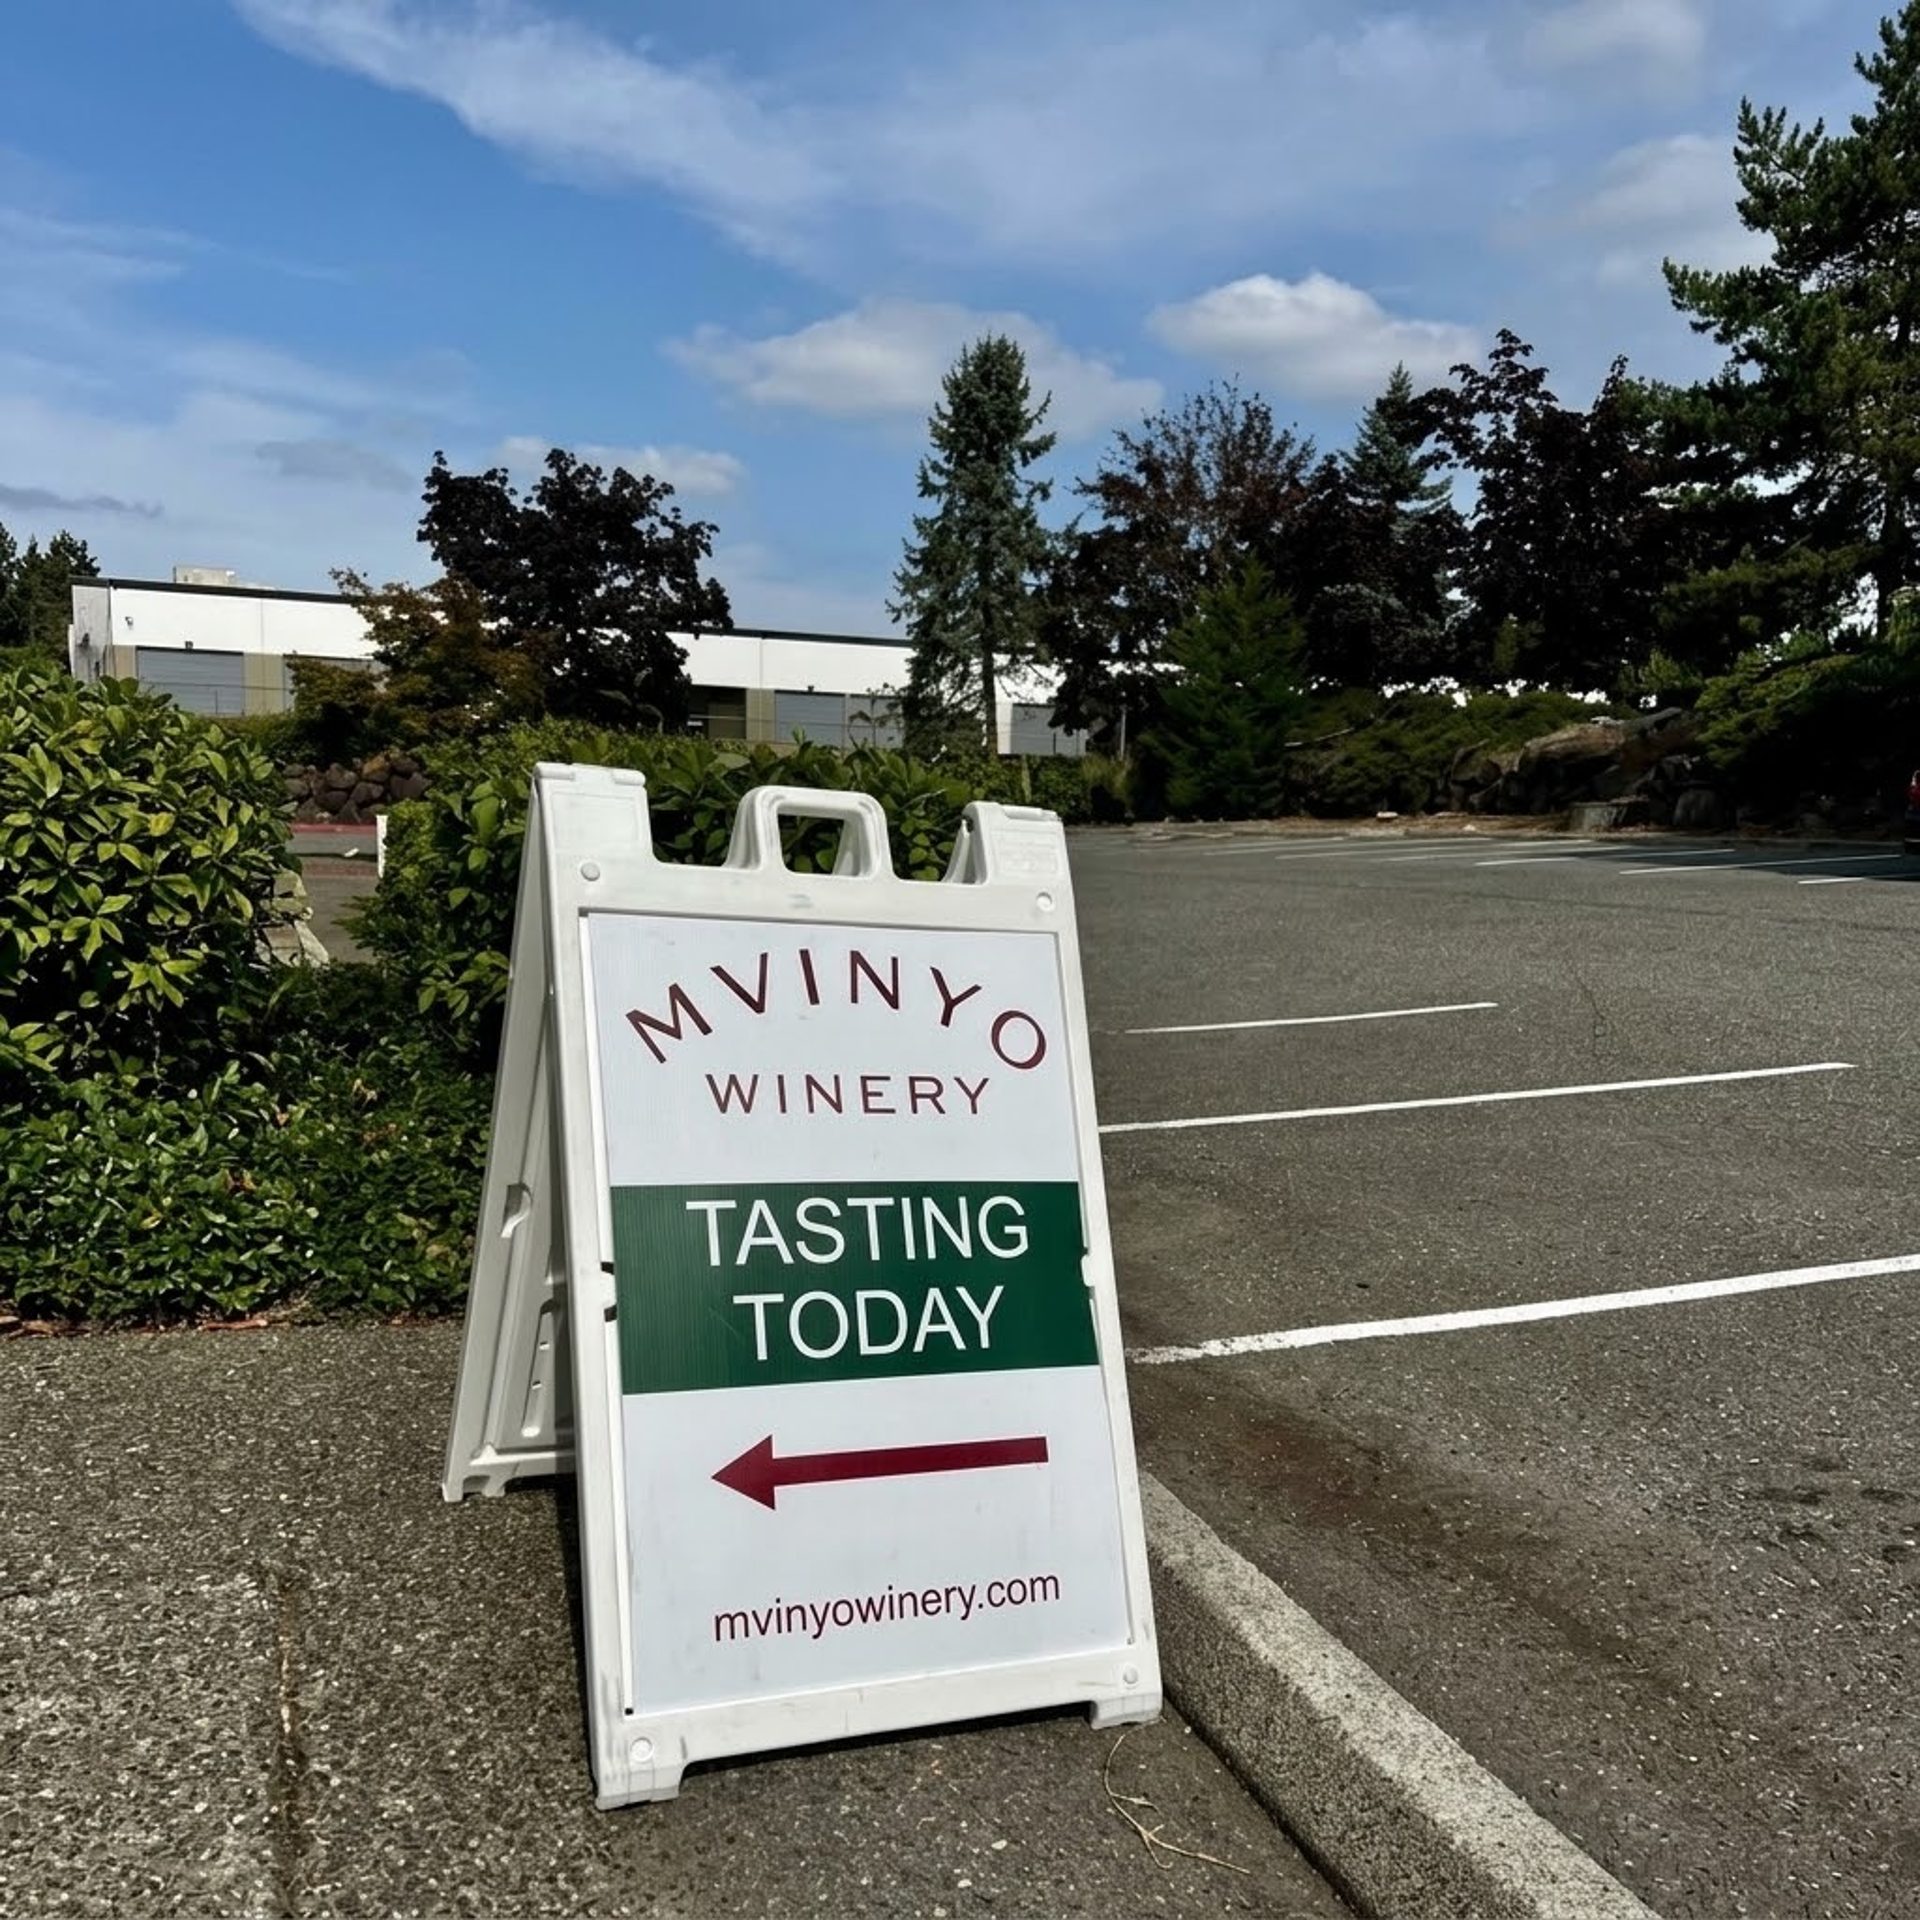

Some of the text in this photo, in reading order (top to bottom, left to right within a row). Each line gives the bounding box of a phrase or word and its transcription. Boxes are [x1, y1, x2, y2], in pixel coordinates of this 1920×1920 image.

[625, 948, 1047, 1071] MVINYO
[705, 1073, 990, 1115] WINERY
[685, 1195, 1029, 1267] TASTING
[732, 1285, 1004, 1361] TODAY
[714, 1575, 1060, 1642] mvinyowinery.com
